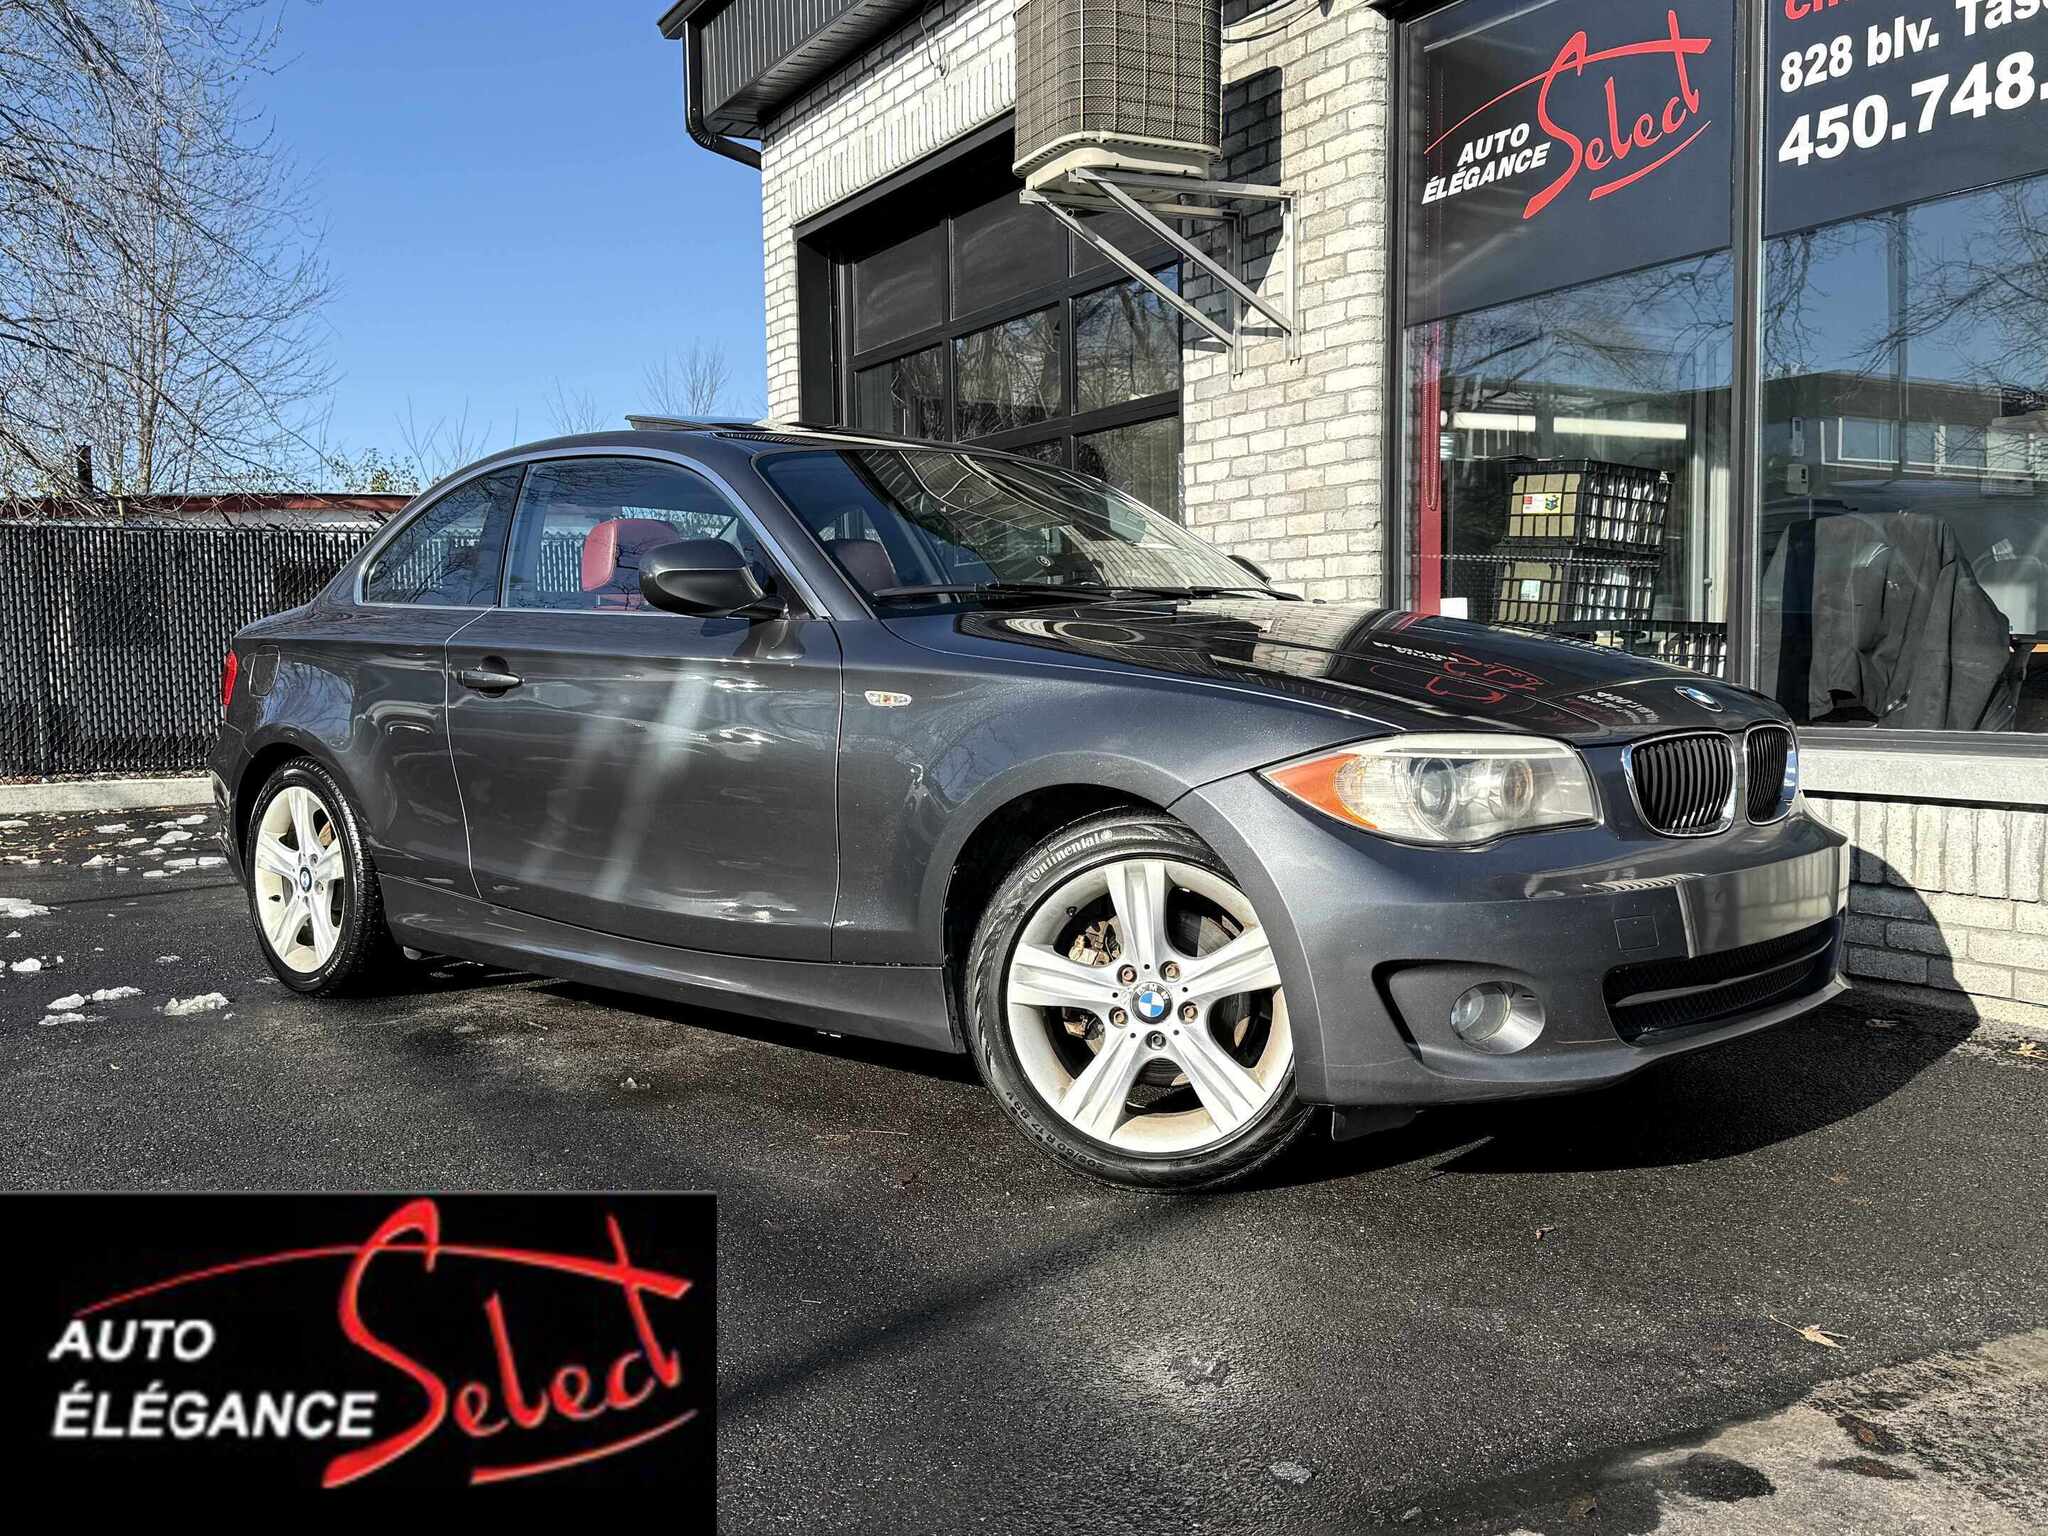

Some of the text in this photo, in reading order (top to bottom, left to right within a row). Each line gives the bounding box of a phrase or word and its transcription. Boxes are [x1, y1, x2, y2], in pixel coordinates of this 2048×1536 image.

[1779, 0, 2048, 93] 828 blv. Tas
[1456, 122, 1530, 167] AUTO
[1522, 9, 1711, 219] Select
[1421, 141, 1551, 205] ÉLÉGANCE
